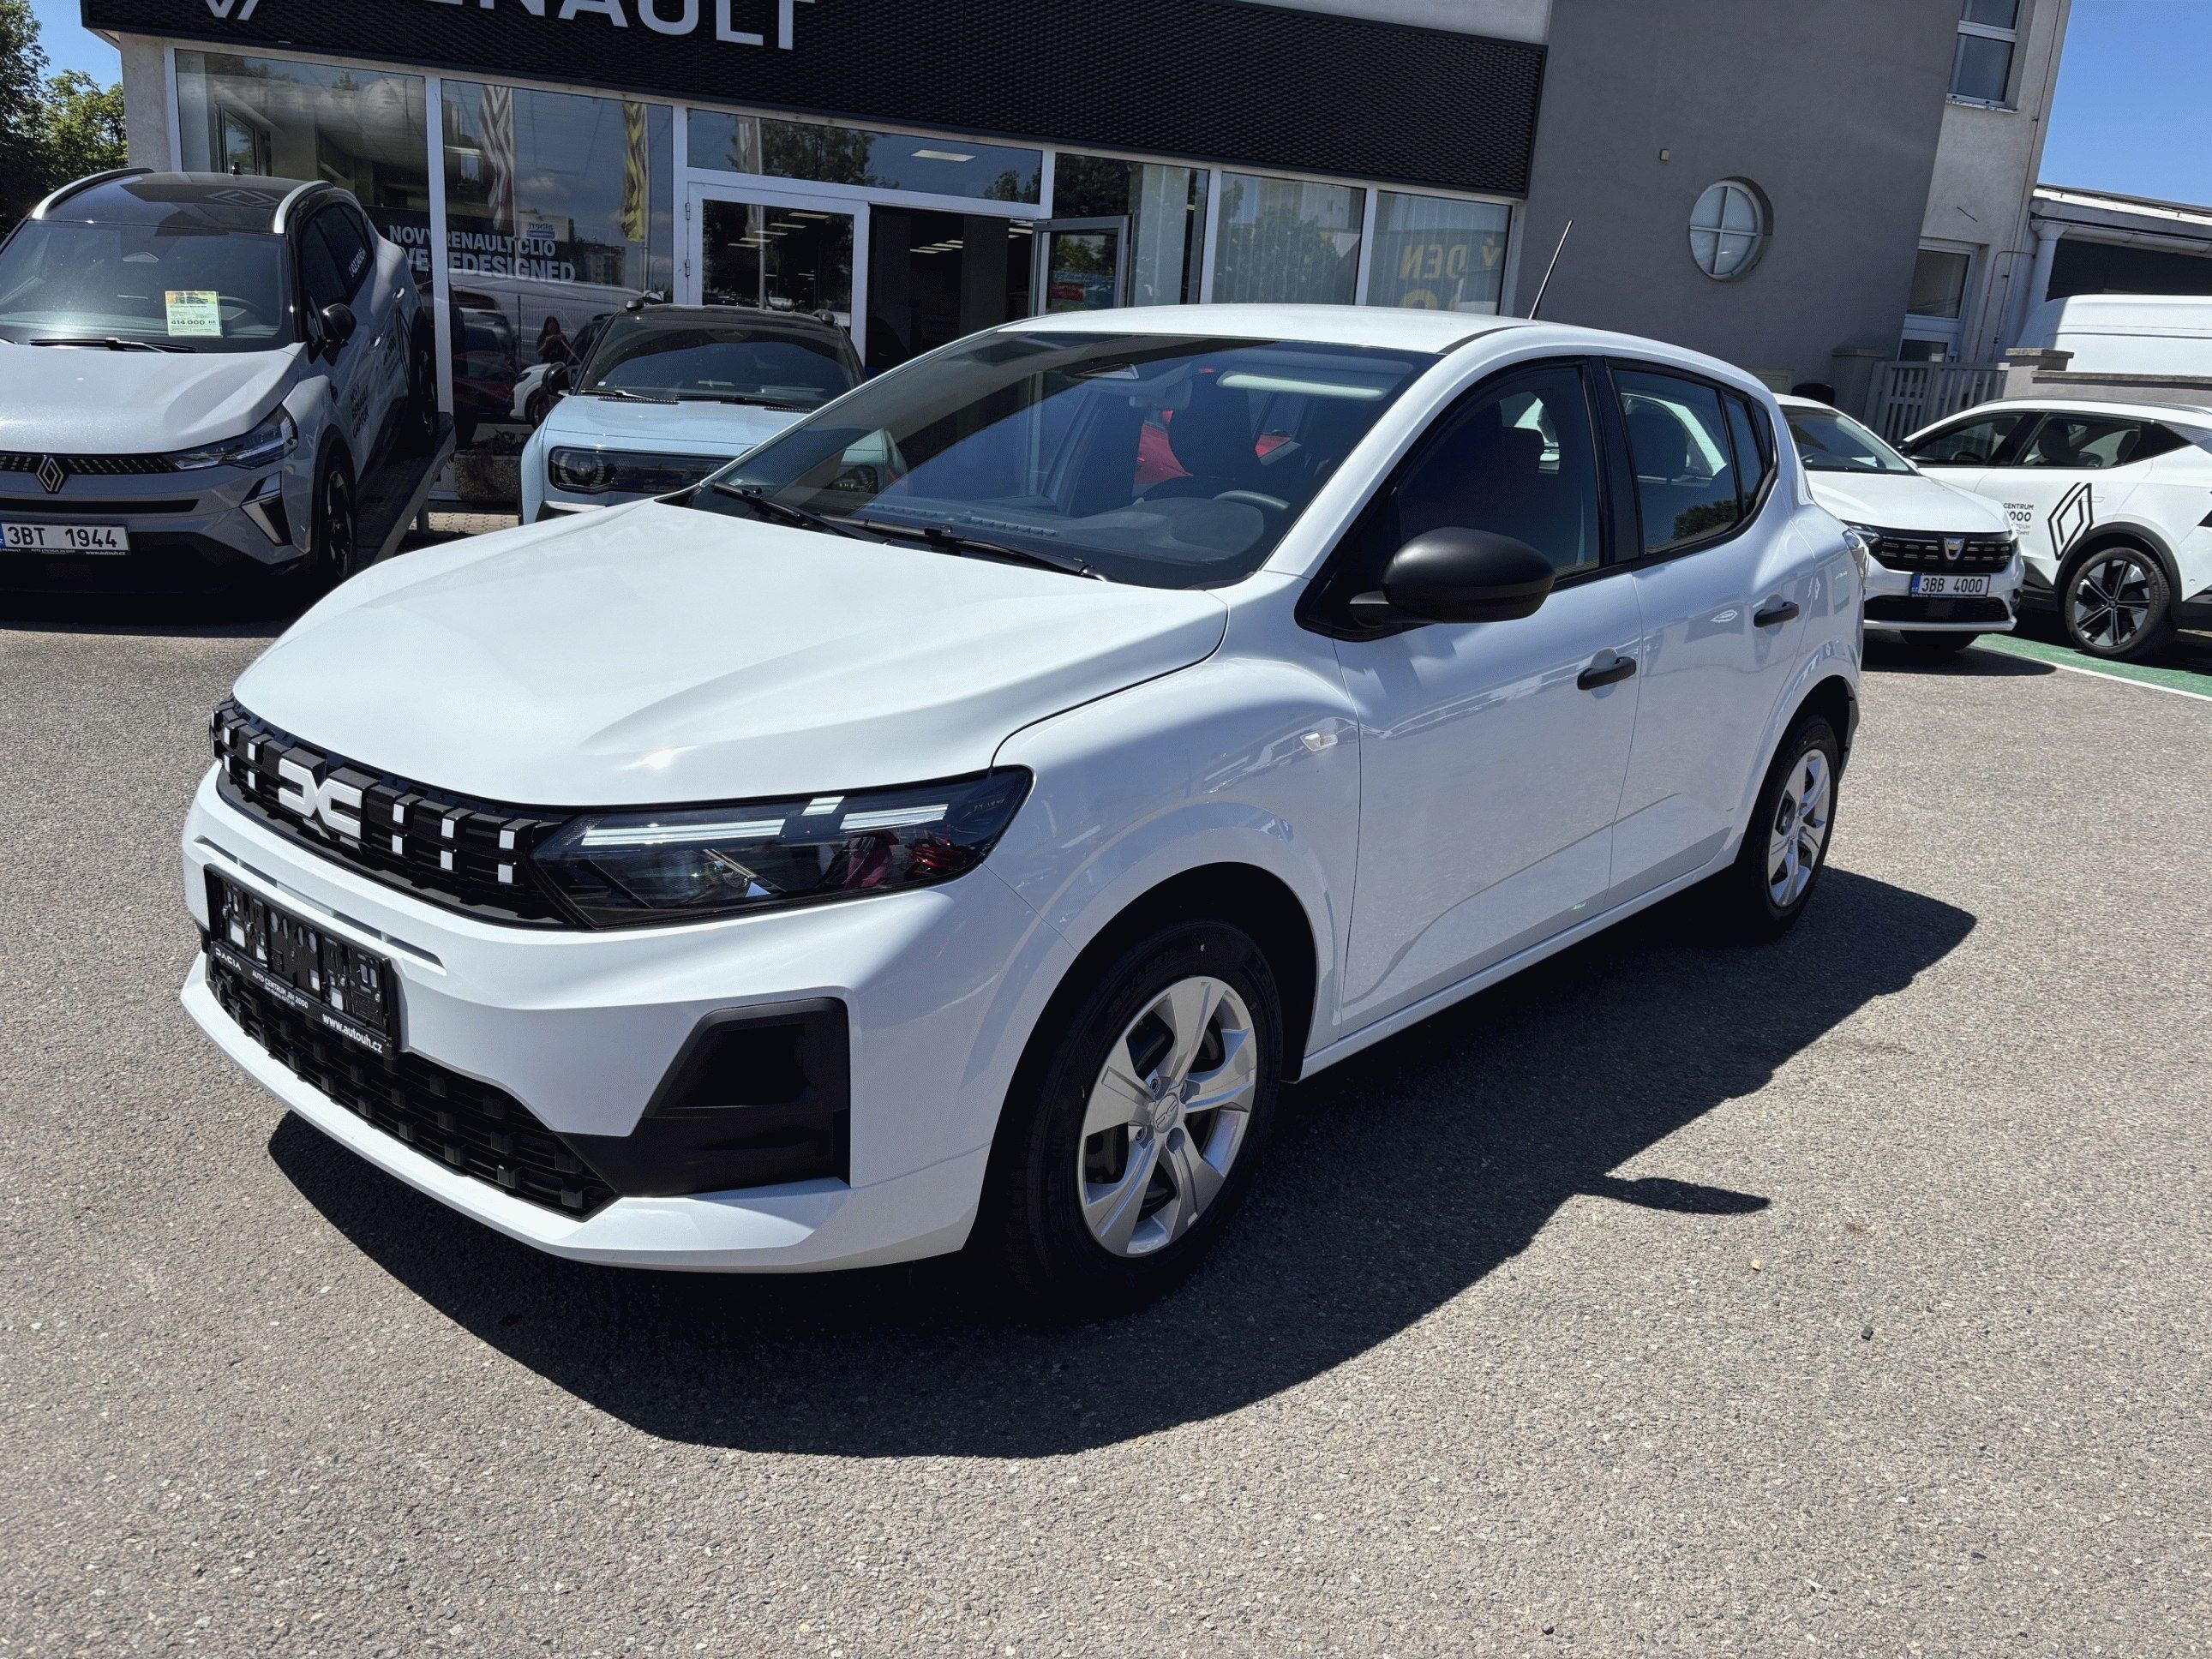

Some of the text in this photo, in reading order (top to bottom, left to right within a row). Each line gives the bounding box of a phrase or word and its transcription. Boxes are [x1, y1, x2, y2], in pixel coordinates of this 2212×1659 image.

[517, 237, 556, 257] CLIO
[448, 251, 576, 284] EDESIGNED
[2006, 511, 2032, 522] 000
[8, 526, 117, 548] 3BT 1944
[1921, 578, 1983, 593] 3BB 4000
[215, 947, 242, 971] DACIA
[264, 977, 287, 997] CENTRUM
[295, 996, 309, 1009] 2000
[322, 1014, 383, 1054] www.autouh.cz
